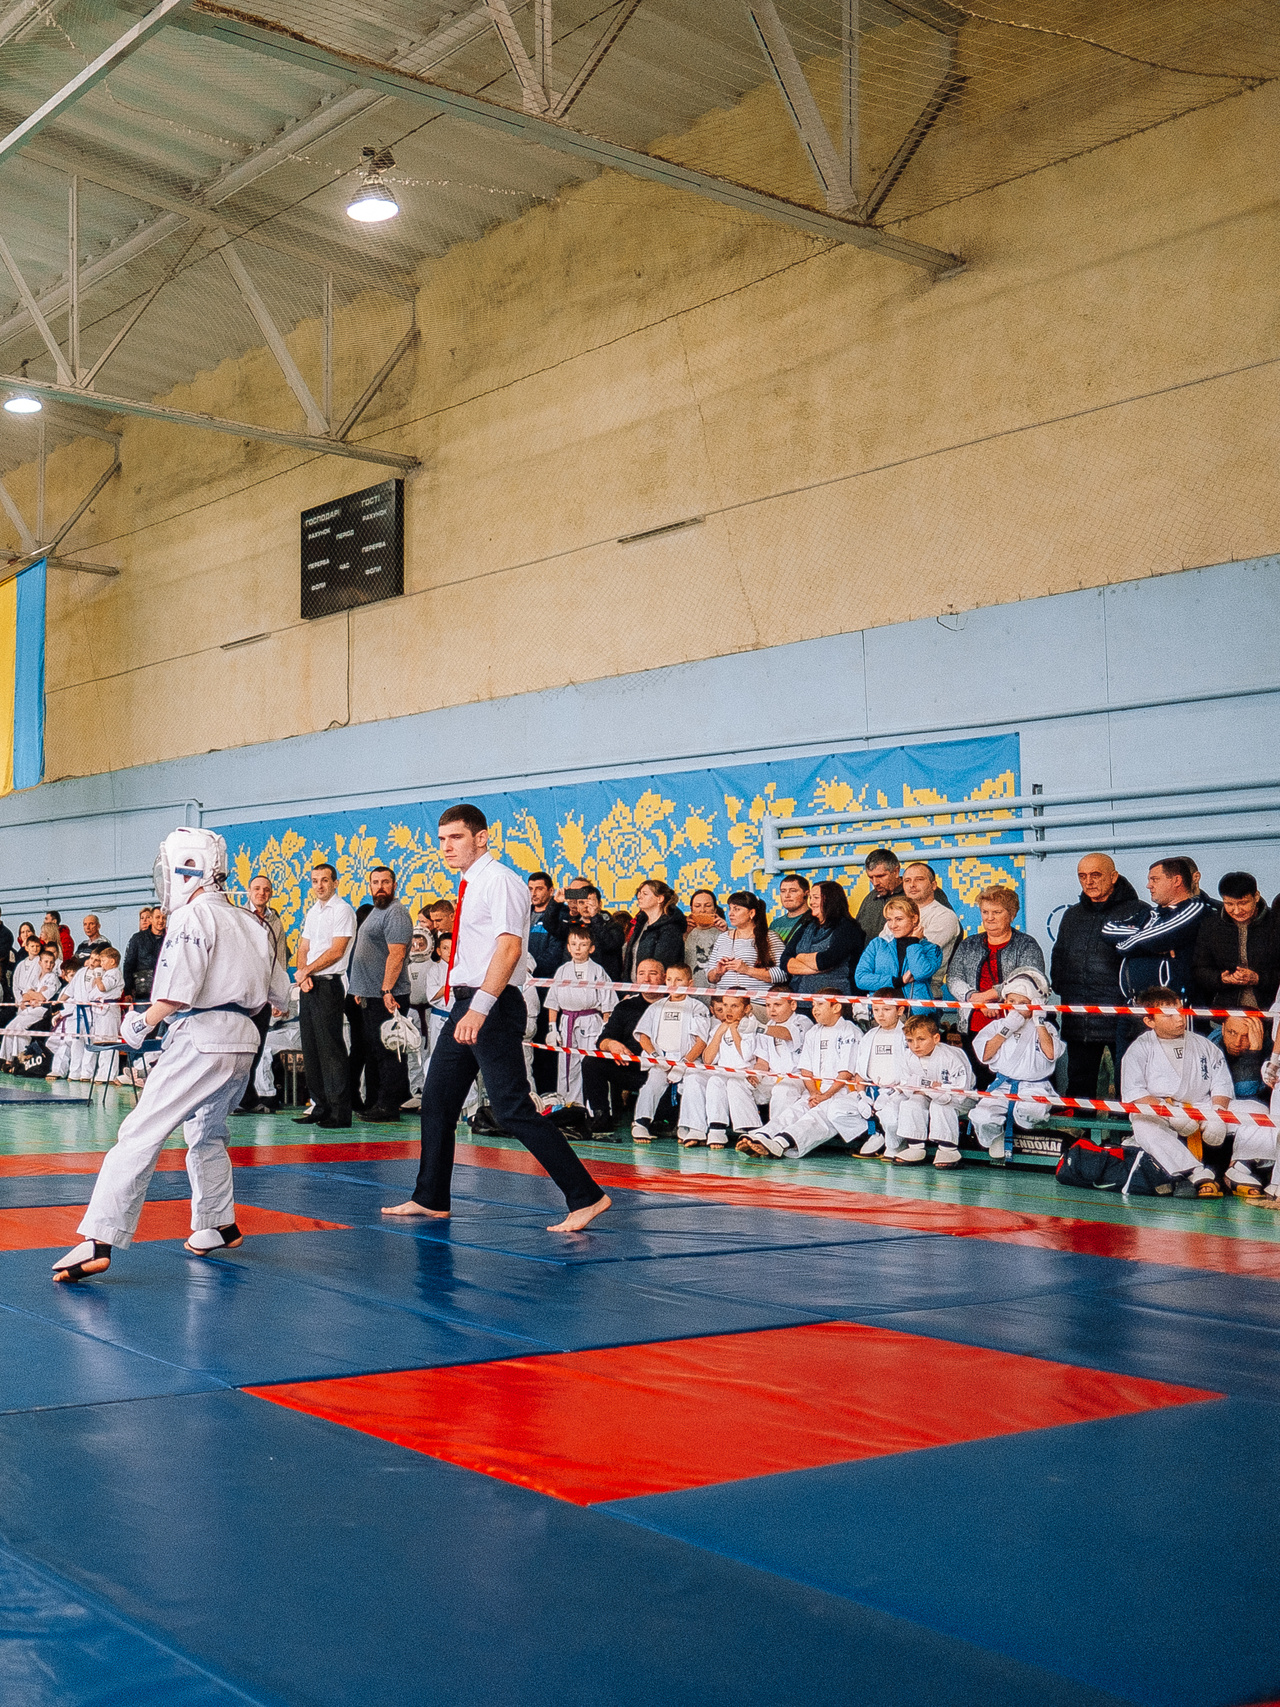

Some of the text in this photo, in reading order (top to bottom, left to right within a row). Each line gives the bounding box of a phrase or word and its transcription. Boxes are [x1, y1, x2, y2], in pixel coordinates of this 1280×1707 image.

[361, 495, 381, 507] ГОСТІ
[305, 508, 341, 527] ГОСПОДАРІ
[362, 509, 387, 521] РАХУНОК
[308, 528, 331, 540] РАХУНОК
[362, 541, 386, 553] ПЕРЕРВА
[307, 558, 330, 570] ПЕРЕРВА
[339, 562, 350, 570] ЧАС
[365, 565, 382, 575] ФОЛИ
[311, 582, 326, 591] ФОЛИ
[1013, 1138, 1062, 1152] ENDOKAI
